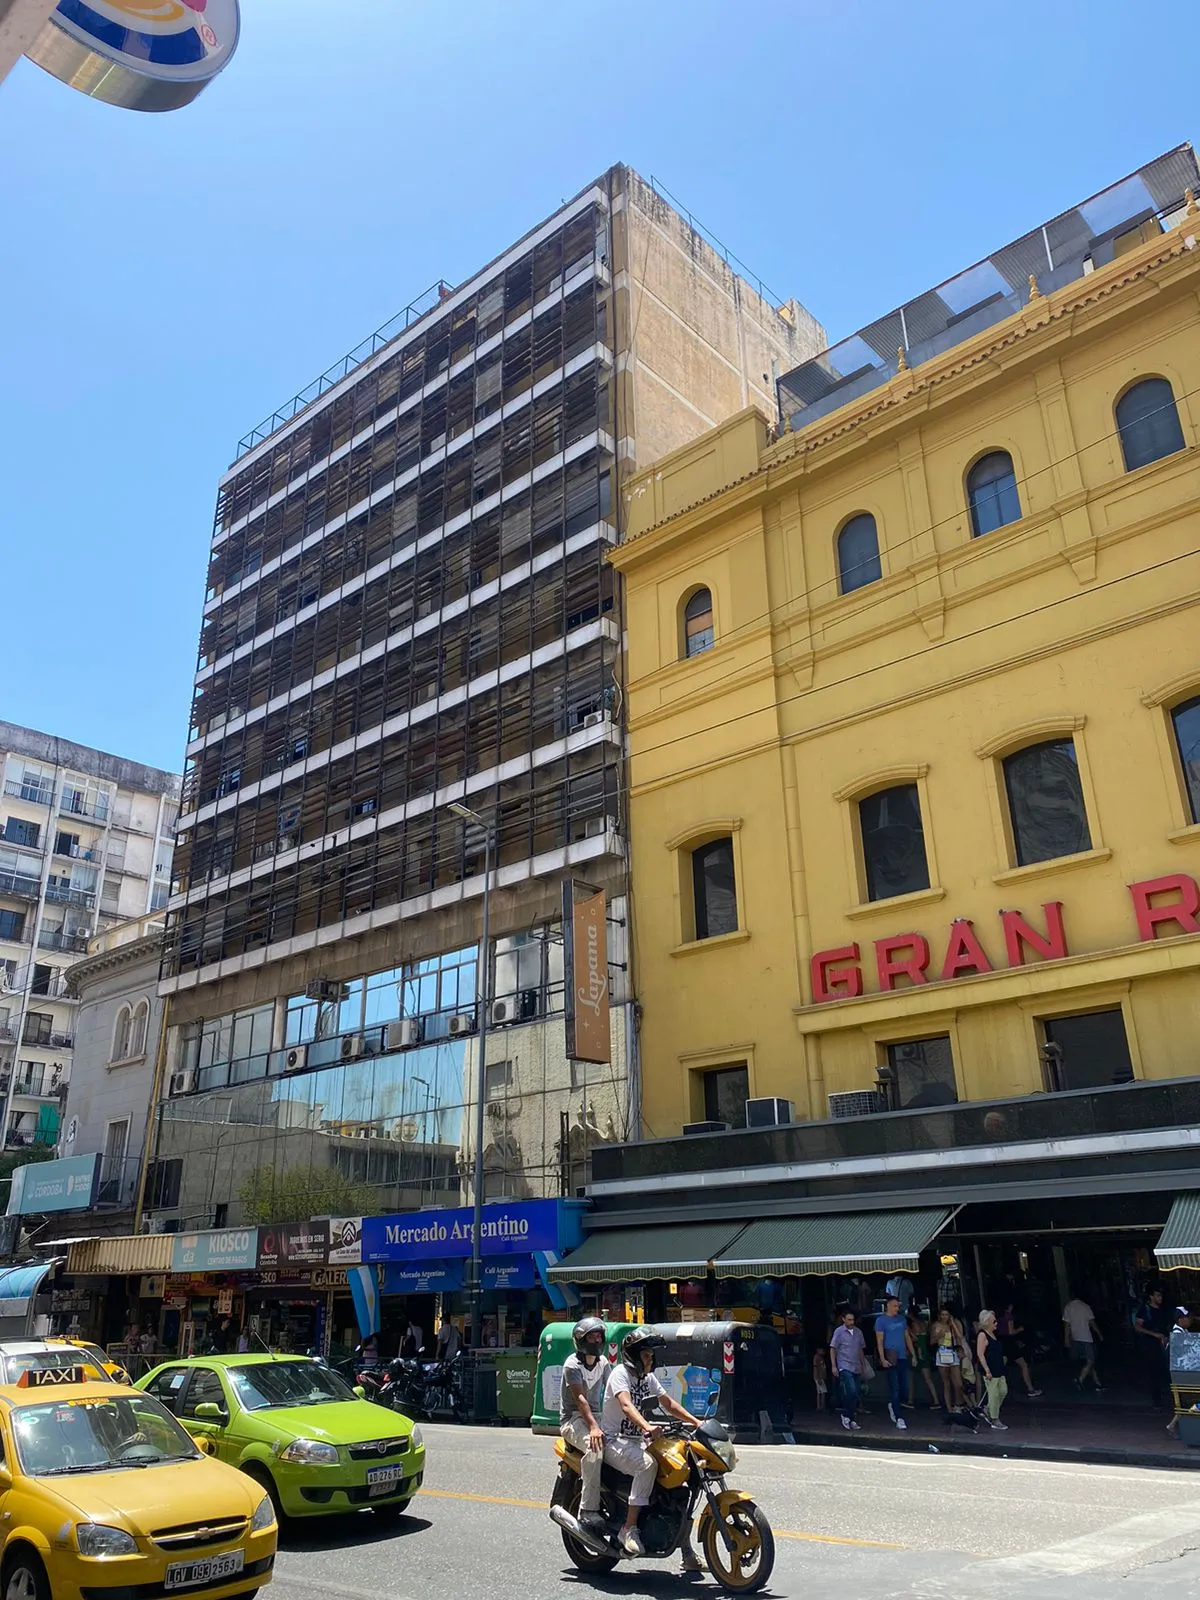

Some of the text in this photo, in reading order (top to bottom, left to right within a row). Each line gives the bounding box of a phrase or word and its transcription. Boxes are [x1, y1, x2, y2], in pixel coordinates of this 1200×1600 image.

[811, 901, 1069, 1003] GRAN
[578, 925, 607, 1016] Lapana
[209, 1231, 249, 1253] KIOSCO
[385, 1221, 447, 1245] Mercado
[400, 1270, 445, 1279] Mercado Argentino
[32, 1368, 76, 1384] TAXI
[380, 1471, 392, 1481] 276
[167, 1559, 236, 1585] LGV 093 2563
